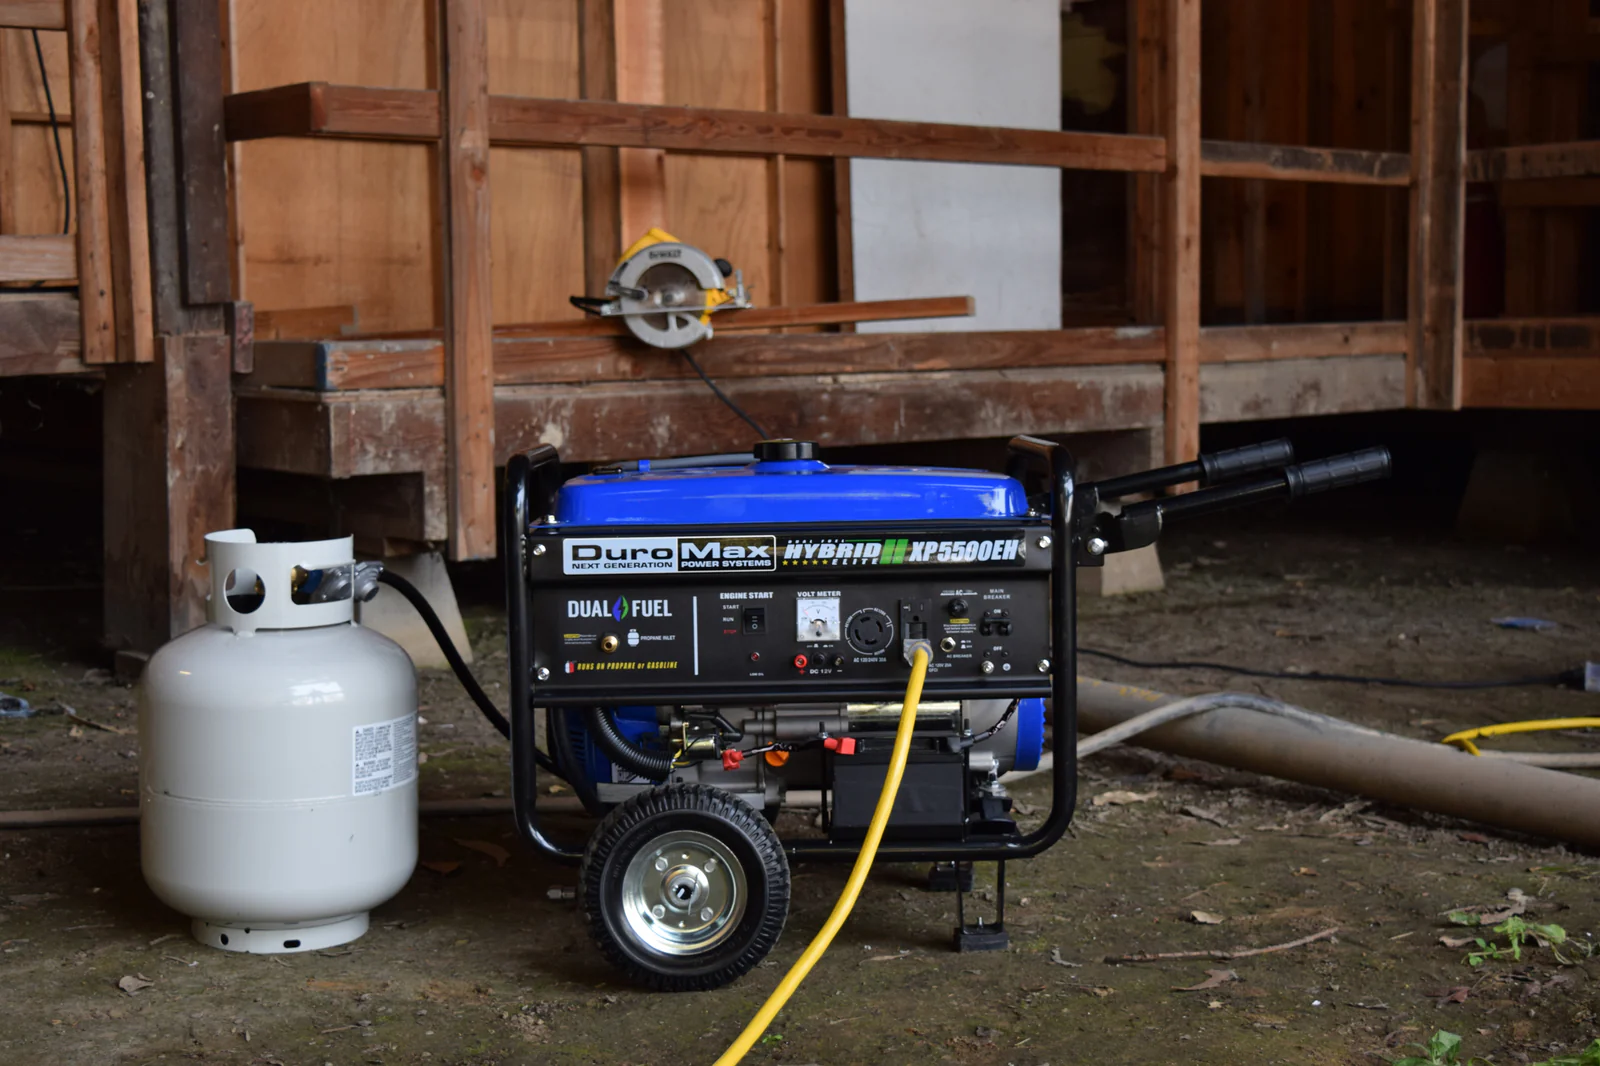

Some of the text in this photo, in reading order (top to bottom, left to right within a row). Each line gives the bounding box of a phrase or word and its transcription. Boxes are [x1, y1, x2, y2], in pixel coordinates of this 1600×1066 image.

[572, 542, 770, 561] Duro Max
[784, 539, 1019, 562] HYBRID XP5500EH
[604, 561, 673, 569] GENERATION
[832, 558, 879, 566] ELITE
[719, 592, 748, 600] ENGINE
[567, 599, 673, 618] DUAL FUEL
[606, 661, 636, 670] PROPANE
[646, 661, 678, 669] GASOLINE
